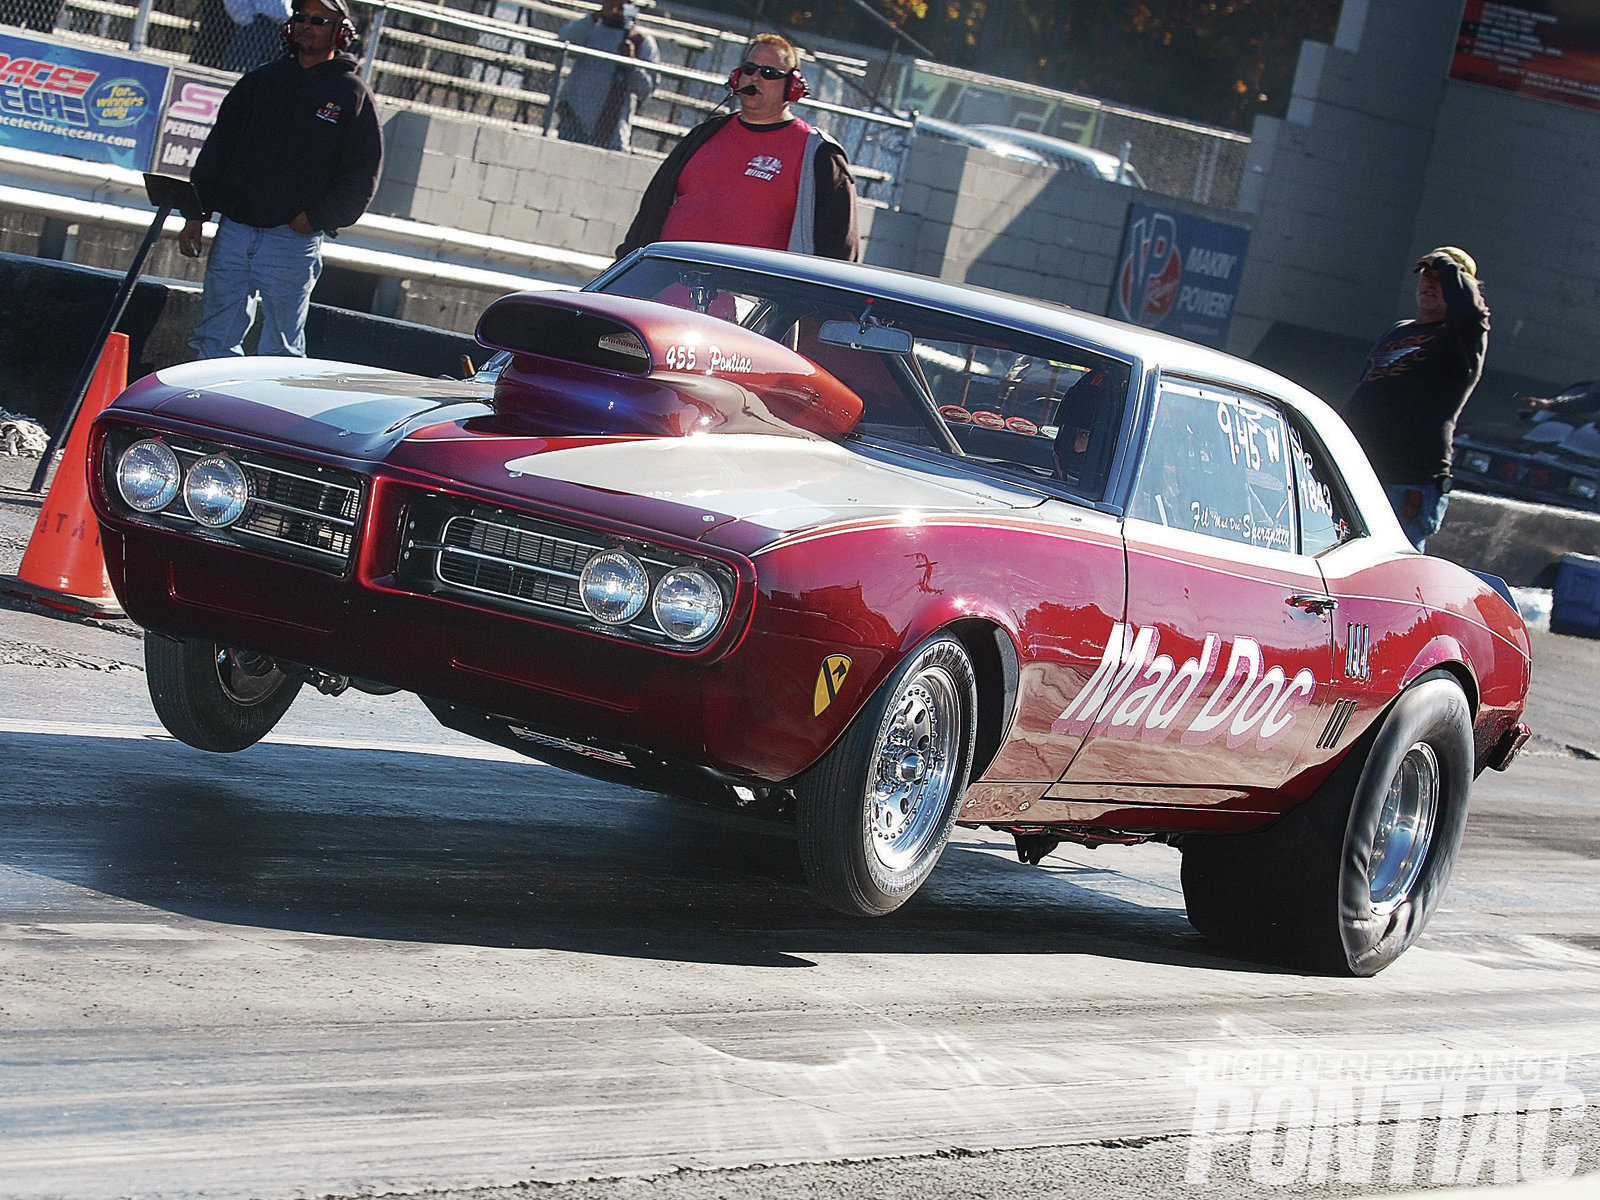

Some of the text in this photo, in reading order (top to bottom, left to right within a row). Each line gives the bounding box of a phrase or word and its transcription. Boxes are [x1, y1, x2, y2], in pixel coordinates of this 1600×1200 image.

[96, 96, 145, 107] winners
[101, 106, 129, 119] only
[1176, 285, 1235, 319] POWER
[665, 344, 753, 376] 455 Pontiac
[1051, 622, 1316, 751] Mad Doc
